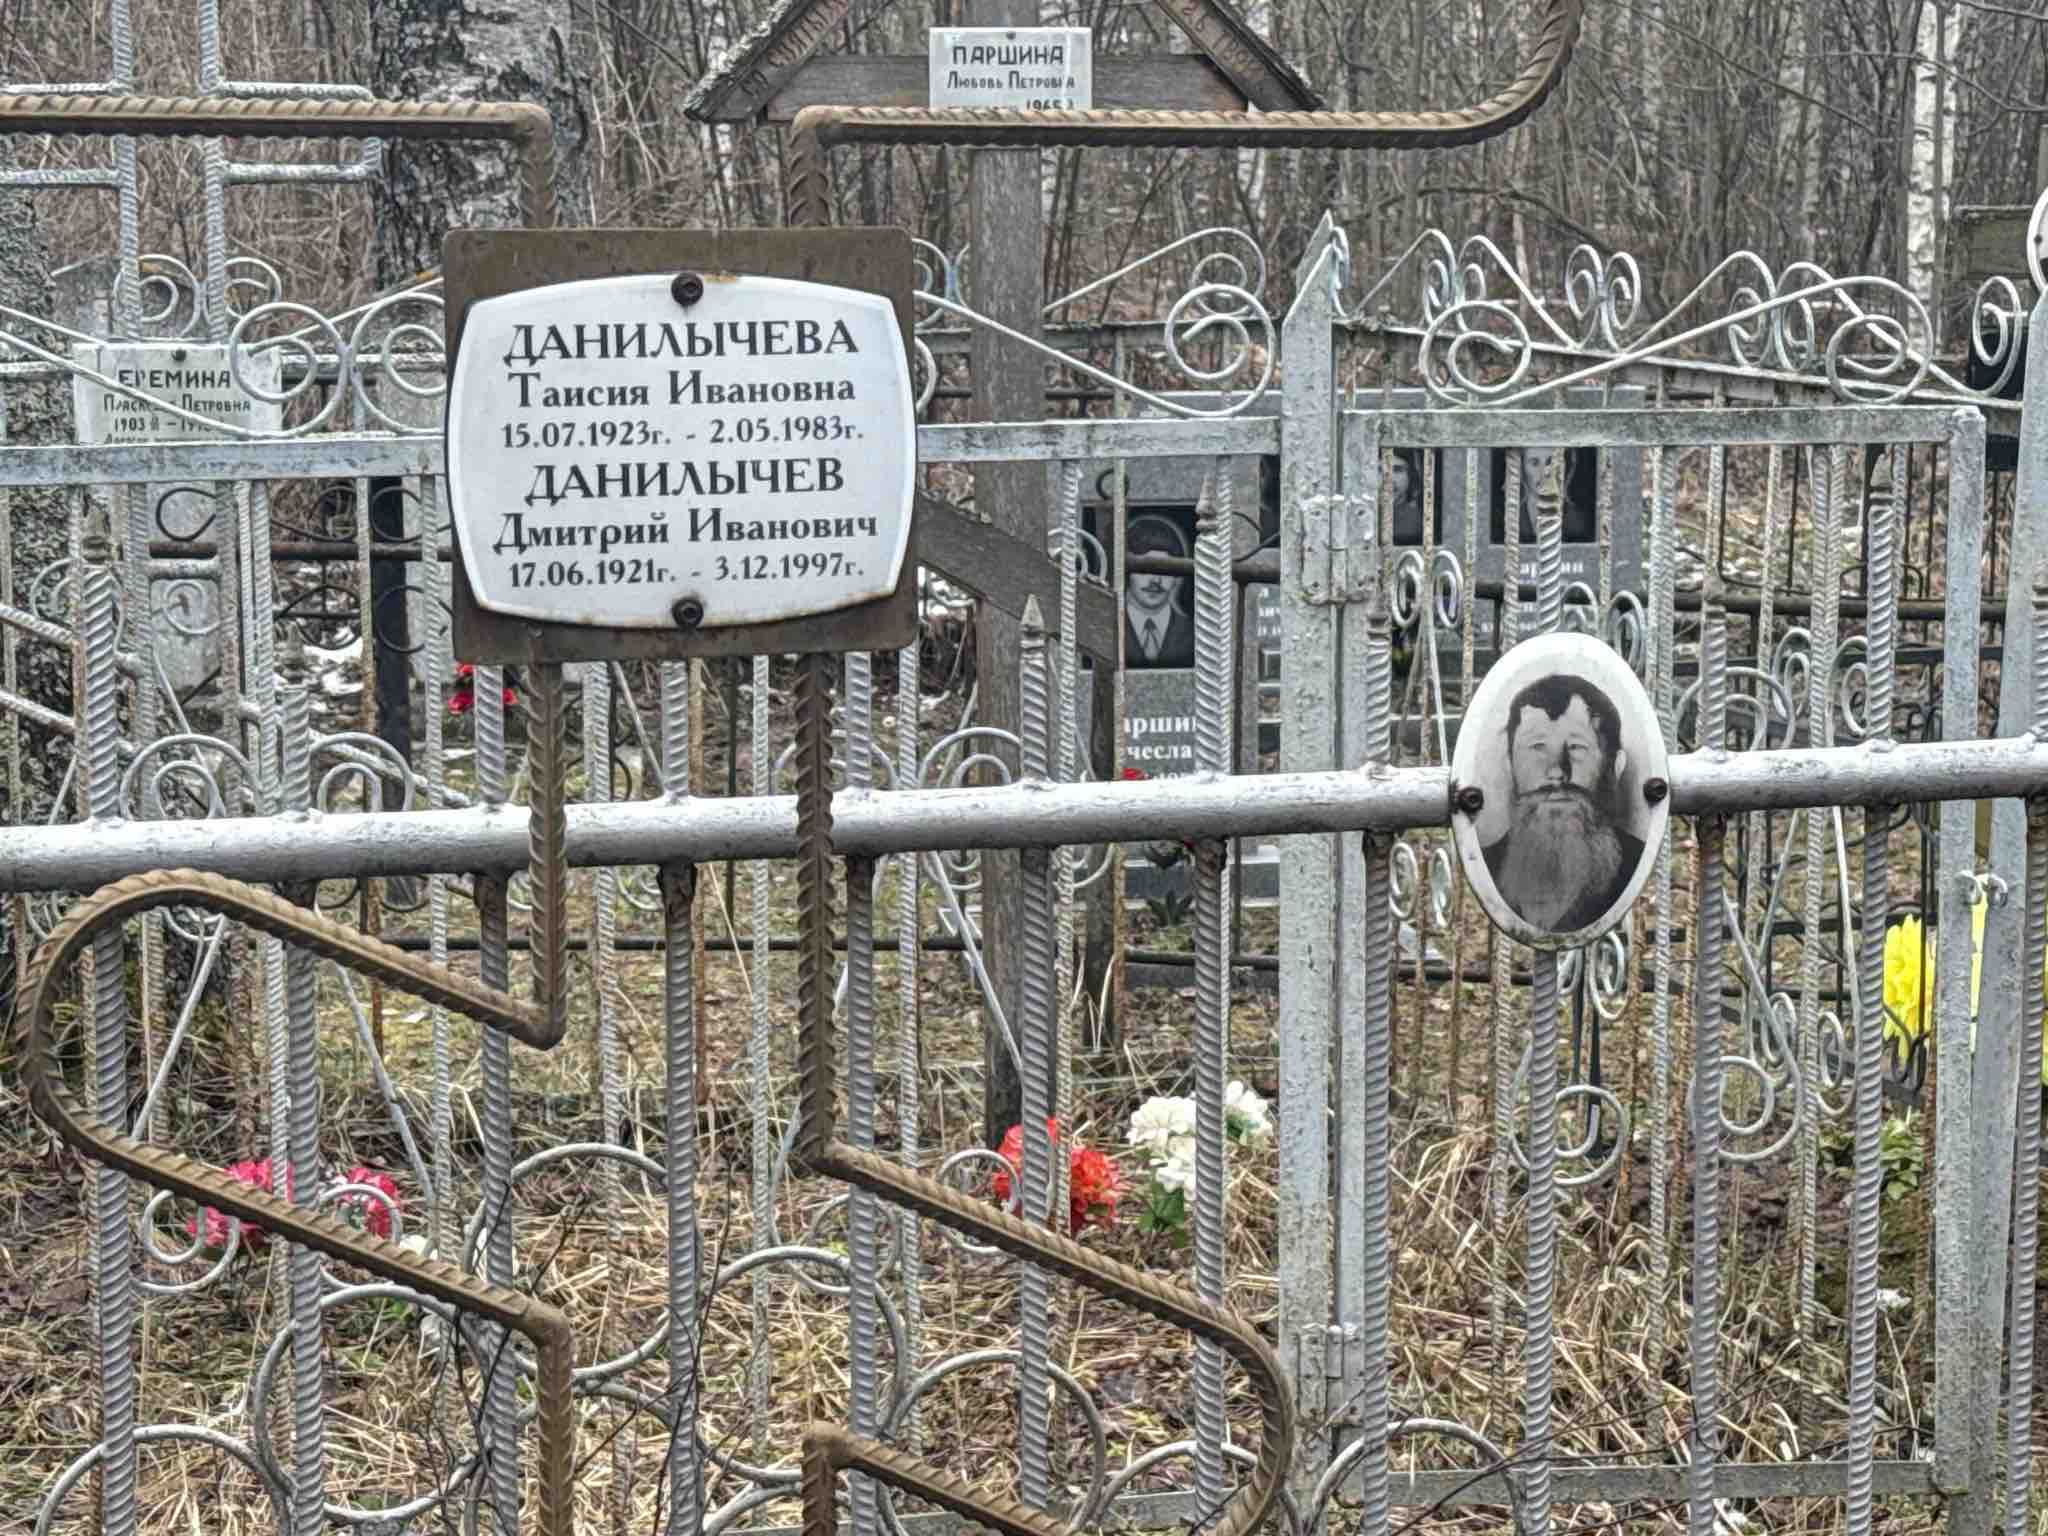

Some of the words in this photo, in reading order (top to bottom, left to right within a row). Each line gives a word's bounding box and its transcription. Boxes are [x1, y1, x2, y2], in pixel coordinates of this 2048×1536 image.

[952, 45, 1064, 65] ПАРШИНА
[503, 318, 859, 368] ДАНИЛЫЧЕВА
[508, 371, 650, 409] Таисия
[668, 368, 857, 405] Ивановна
[502, 420, 672, 449] 15.07.1923г.
[709, 415, 864, 446] 2.05.1983г.
[524, 456, 845, 507] ДАНИЛЫЧЕВ
[493, 511, 670, 555] Дмитрий
[688, 507, 878, 543] Иванович
[509, 558, 677, 589] 17.06.1921г.
[715, 552, 865, 583] 3.12.1997г.
